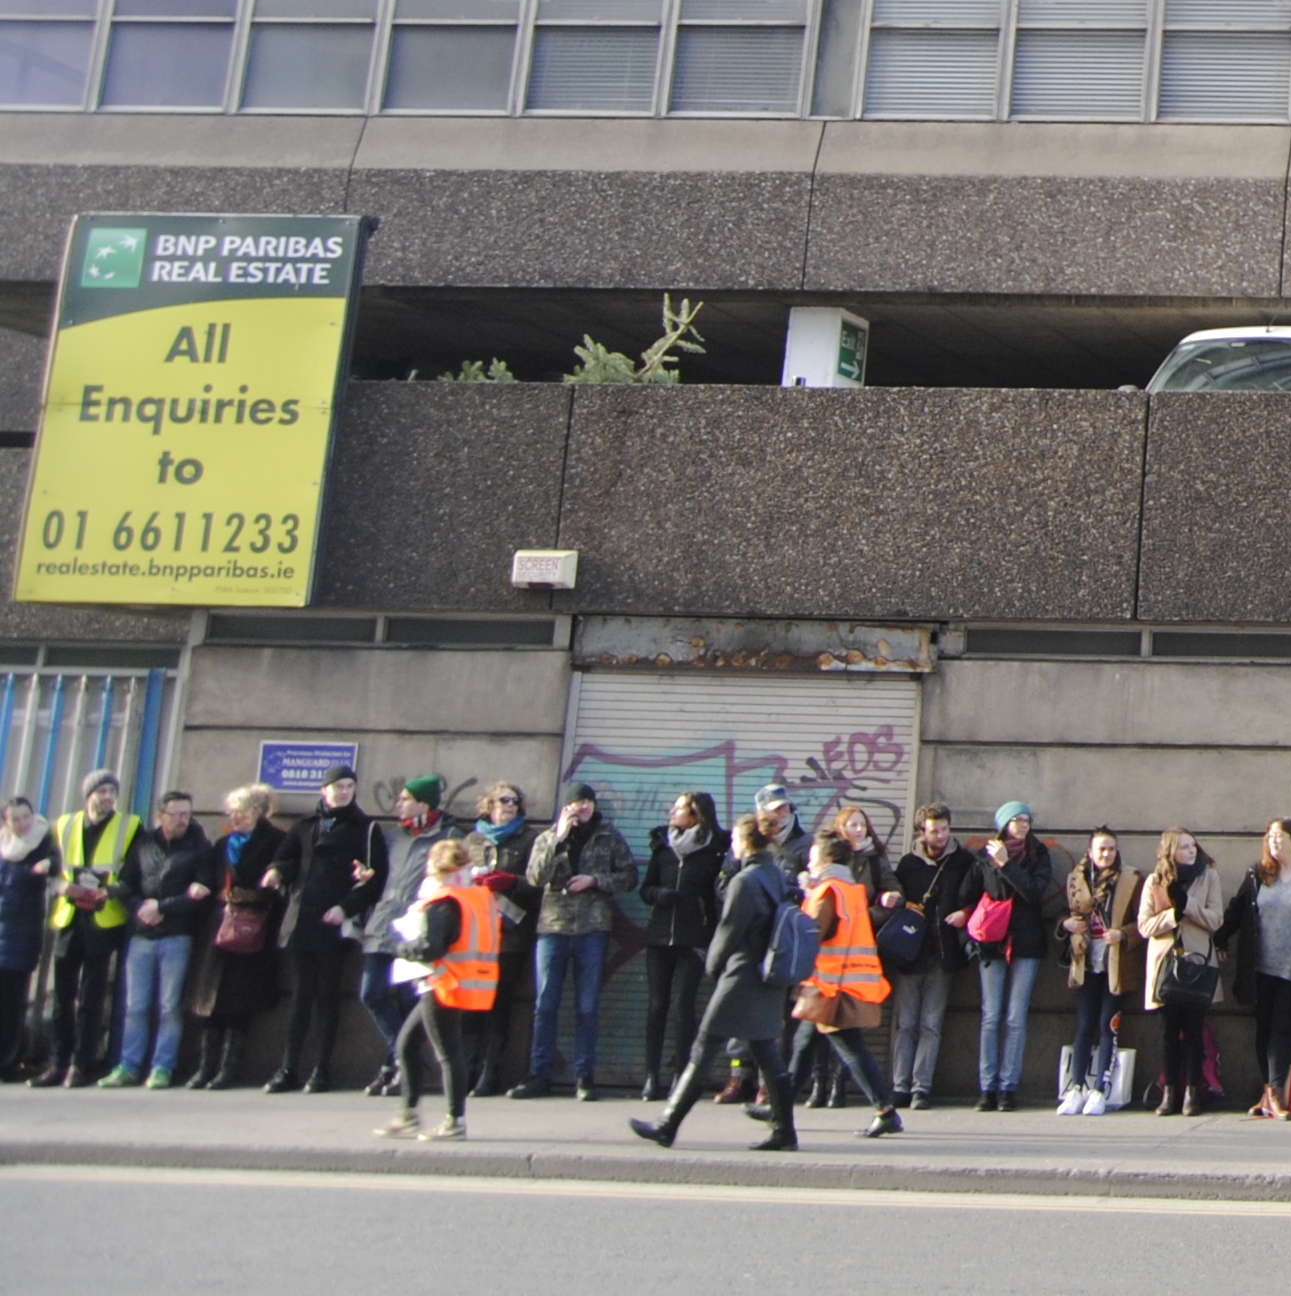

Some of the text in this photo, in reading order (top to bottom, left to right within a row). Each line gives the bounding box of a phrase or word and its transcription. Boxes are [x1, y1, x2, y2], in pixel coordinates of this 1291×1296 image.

[156, 234, 343, 259] BNP PARIBAS
[151, 260, 332, 284] REAL ESTATE
[164, 321, 232, 364] All
[78, 383, 301, 436] Enquiries
[157, 450, 205, 486] to
[42, 509, 300, 554] 01 6611233
[36, 557, 295, 582] realestate.bnpparibas.ie
[518, 558, 559, 571] SCREEN
[283, 758, 330, 767] MANGUARD
